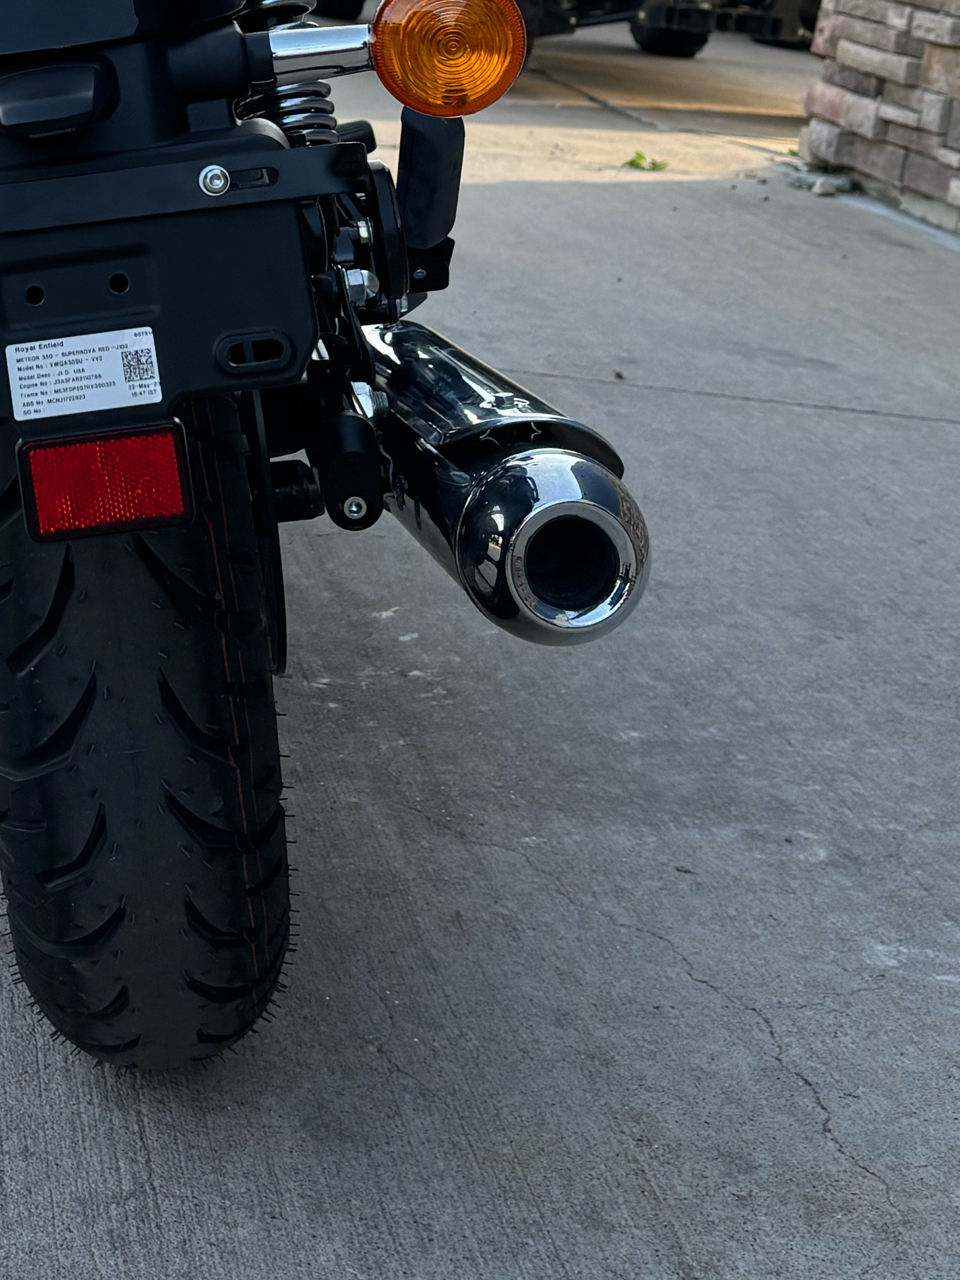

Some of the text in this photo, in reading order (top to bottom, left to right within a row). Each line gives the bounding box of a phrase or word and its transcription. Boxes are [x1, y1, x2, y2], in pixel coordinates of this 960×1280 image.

[15, 341, 64, 354] Royal Enfield
[16, 355, 40, 364] METEOR
[61, 348, 96, 358] SUPERNOVA
[19, 374, 35, 382] Model
[19, 382, 38, 390] Engine
[21, 391, 39, 399] Frame
